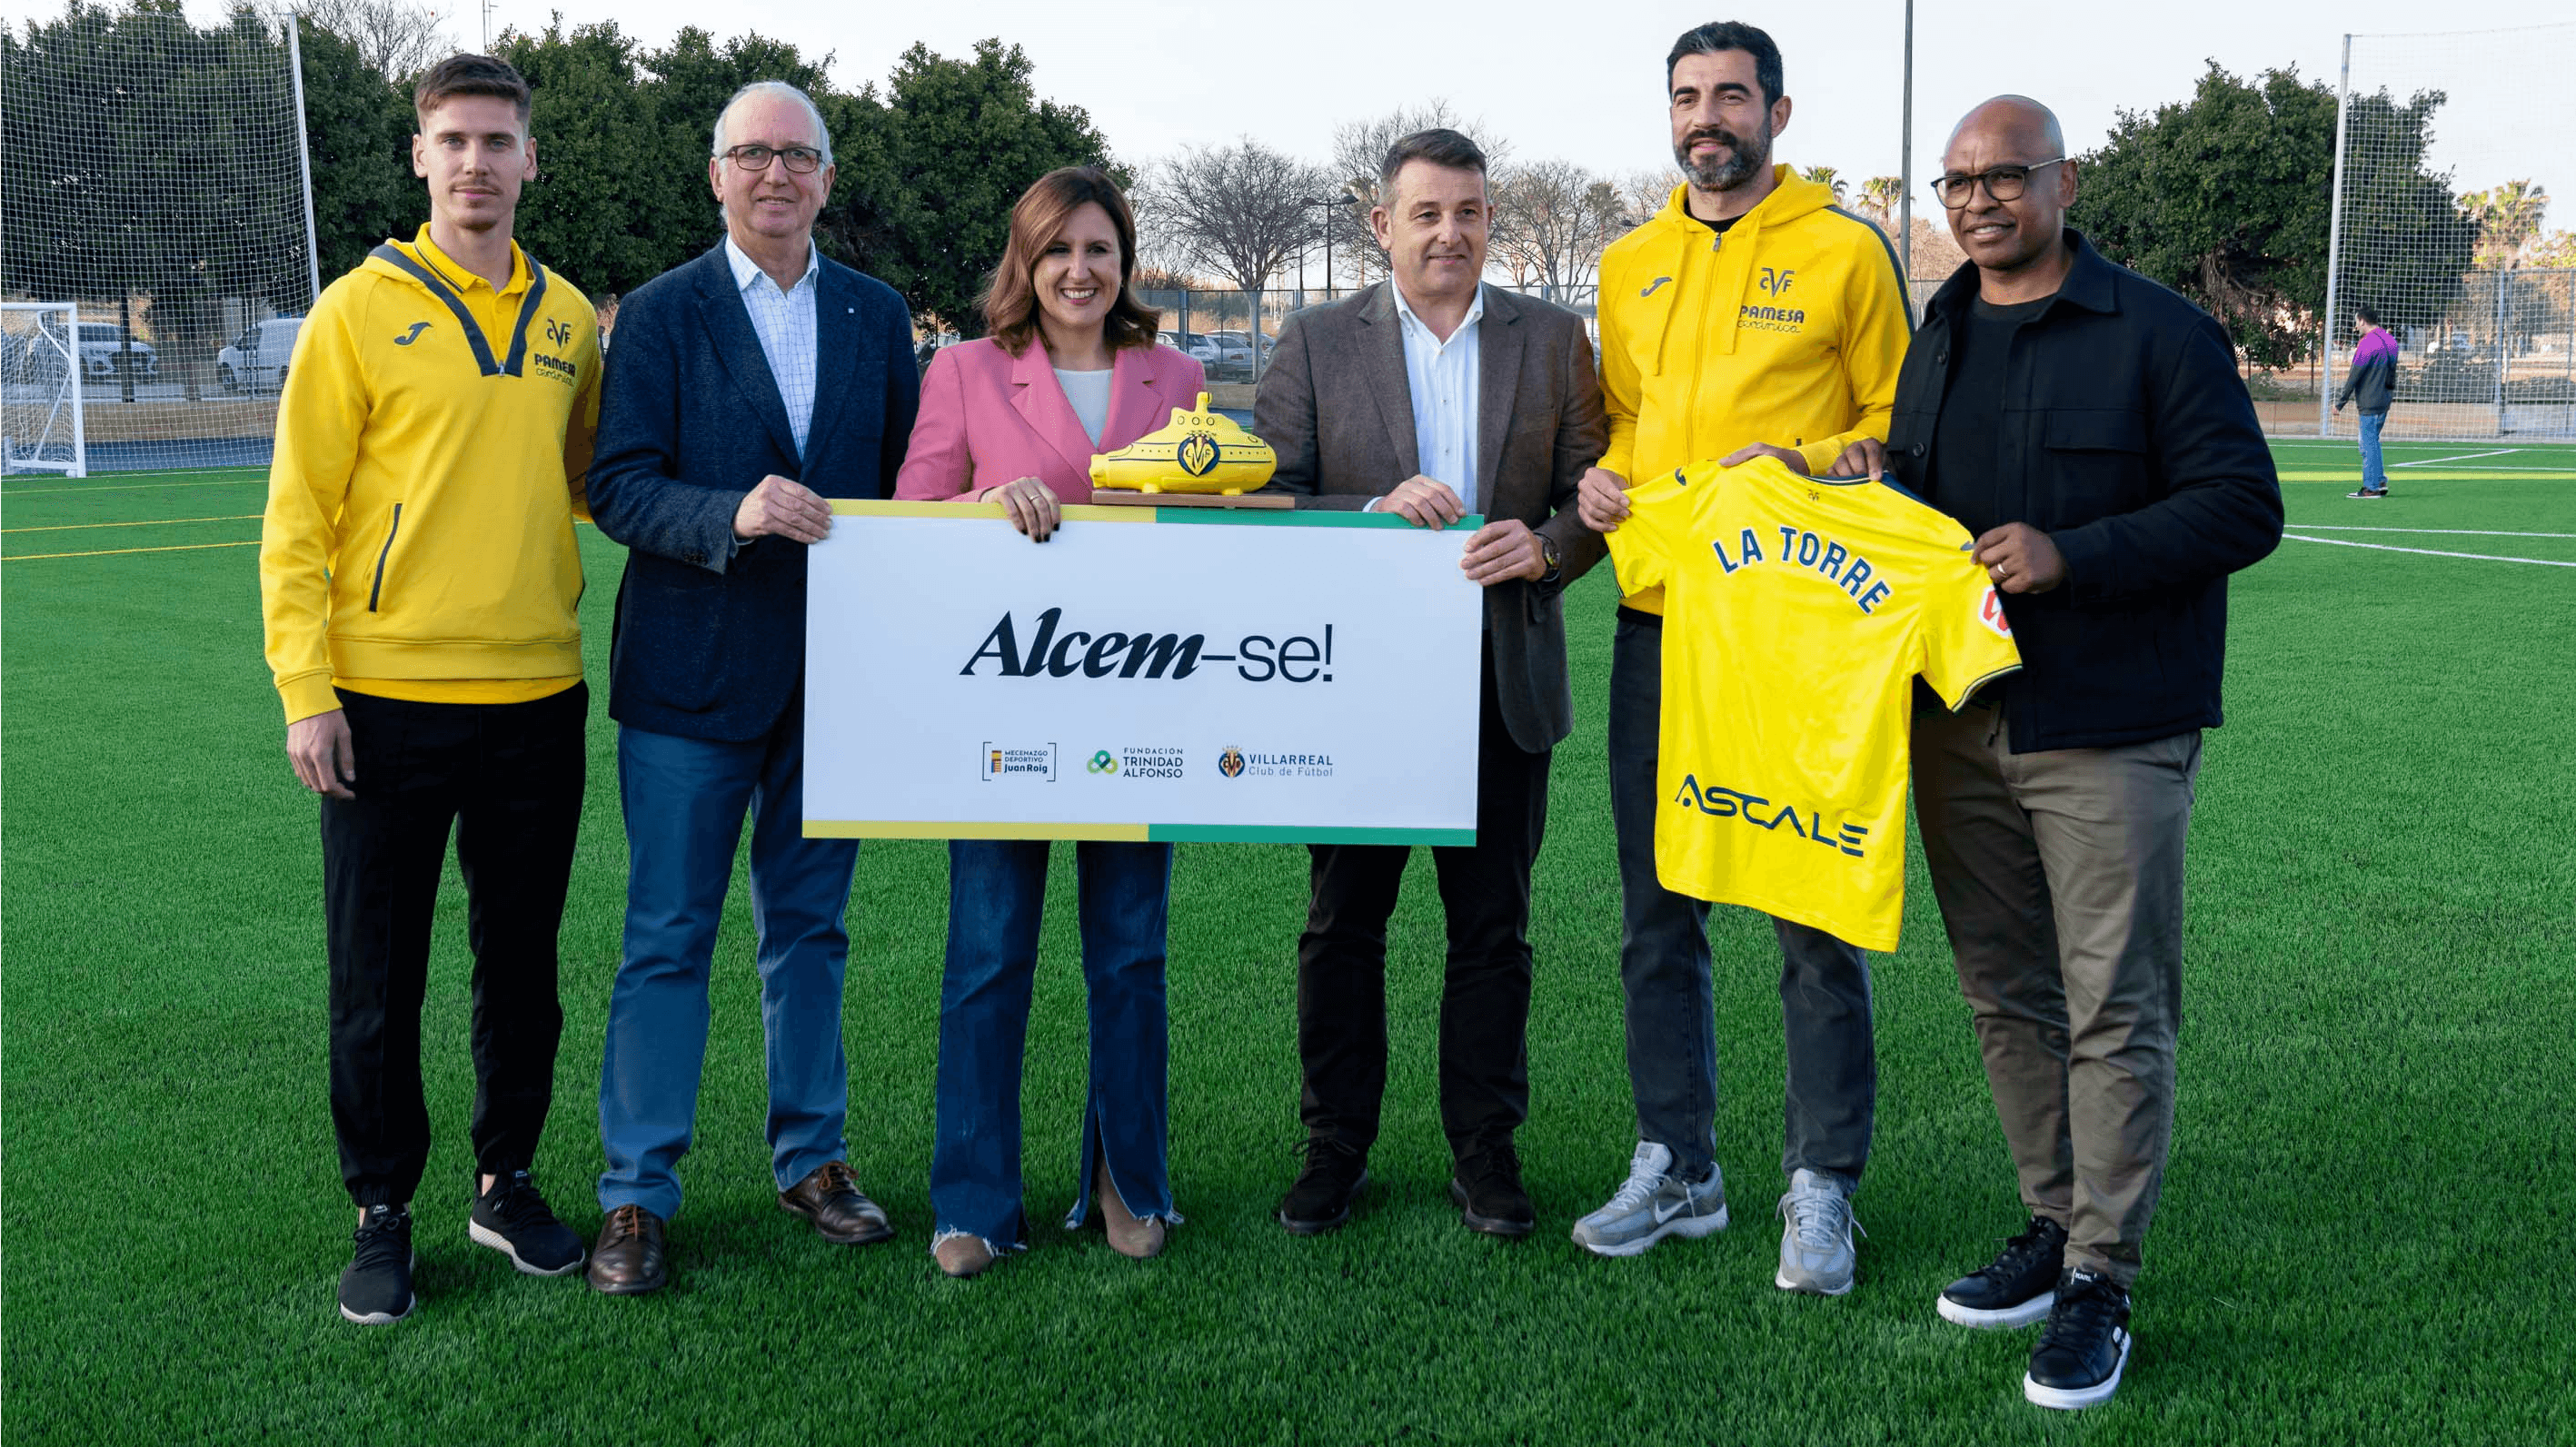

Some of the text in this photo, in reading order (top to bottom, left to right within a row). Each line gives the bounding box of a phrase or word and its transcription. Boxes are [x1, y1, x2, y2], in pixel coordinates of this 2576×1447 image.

[1739, 304, 1805, 323] PAMESA
[1713, 526, 1891, 615] LA TORRE
[1123, 756, 1183, 768] TRINIDAD
[1249, 754, 1333, 766] VILLARREAL
[1004, 764, 1048, 774] Juan Roig
[1123, 768, 1183, 778] ALFONSO
[1248, 766, 1333, 778] Club de Fútbol
[1675, 774, 1868, 857] ASCALE
